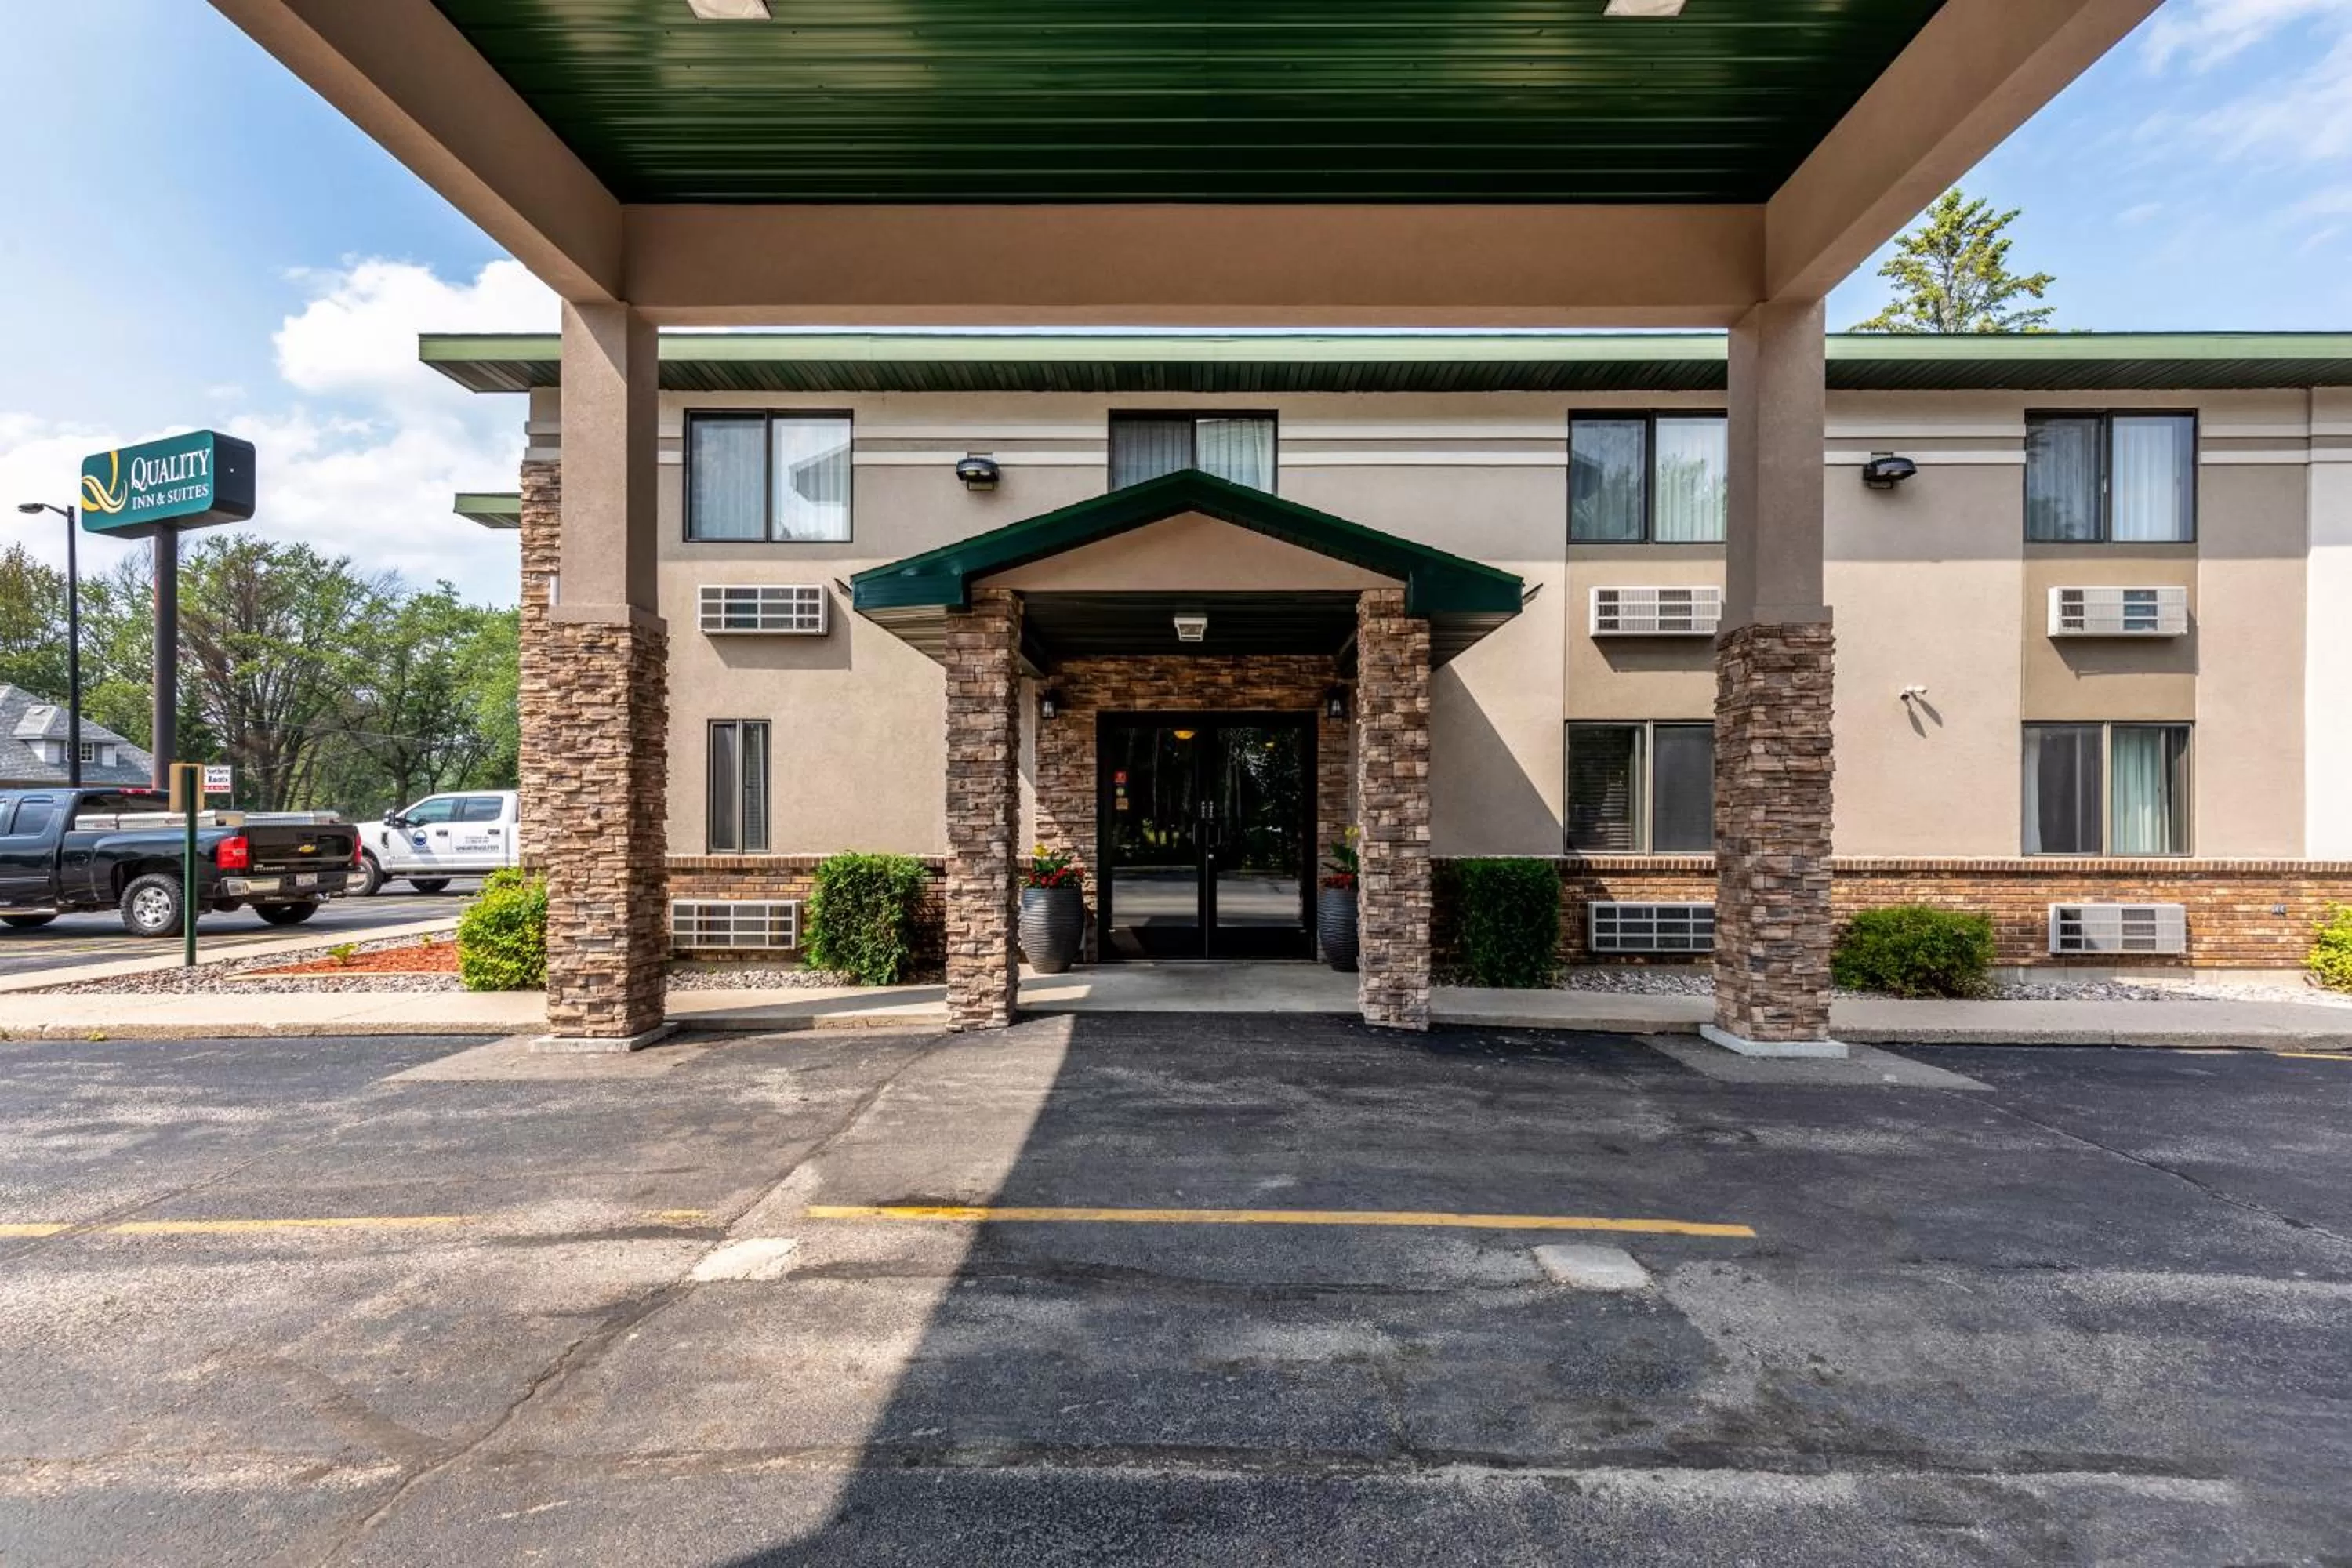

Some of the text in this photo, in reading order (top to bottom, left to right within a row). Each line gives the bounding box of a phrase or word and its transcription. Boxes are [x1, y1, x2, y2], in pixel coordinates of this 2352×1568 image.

[131, 448, 210, 492] QUALITY
[132, 483, 209, 510] INN & SUITES
